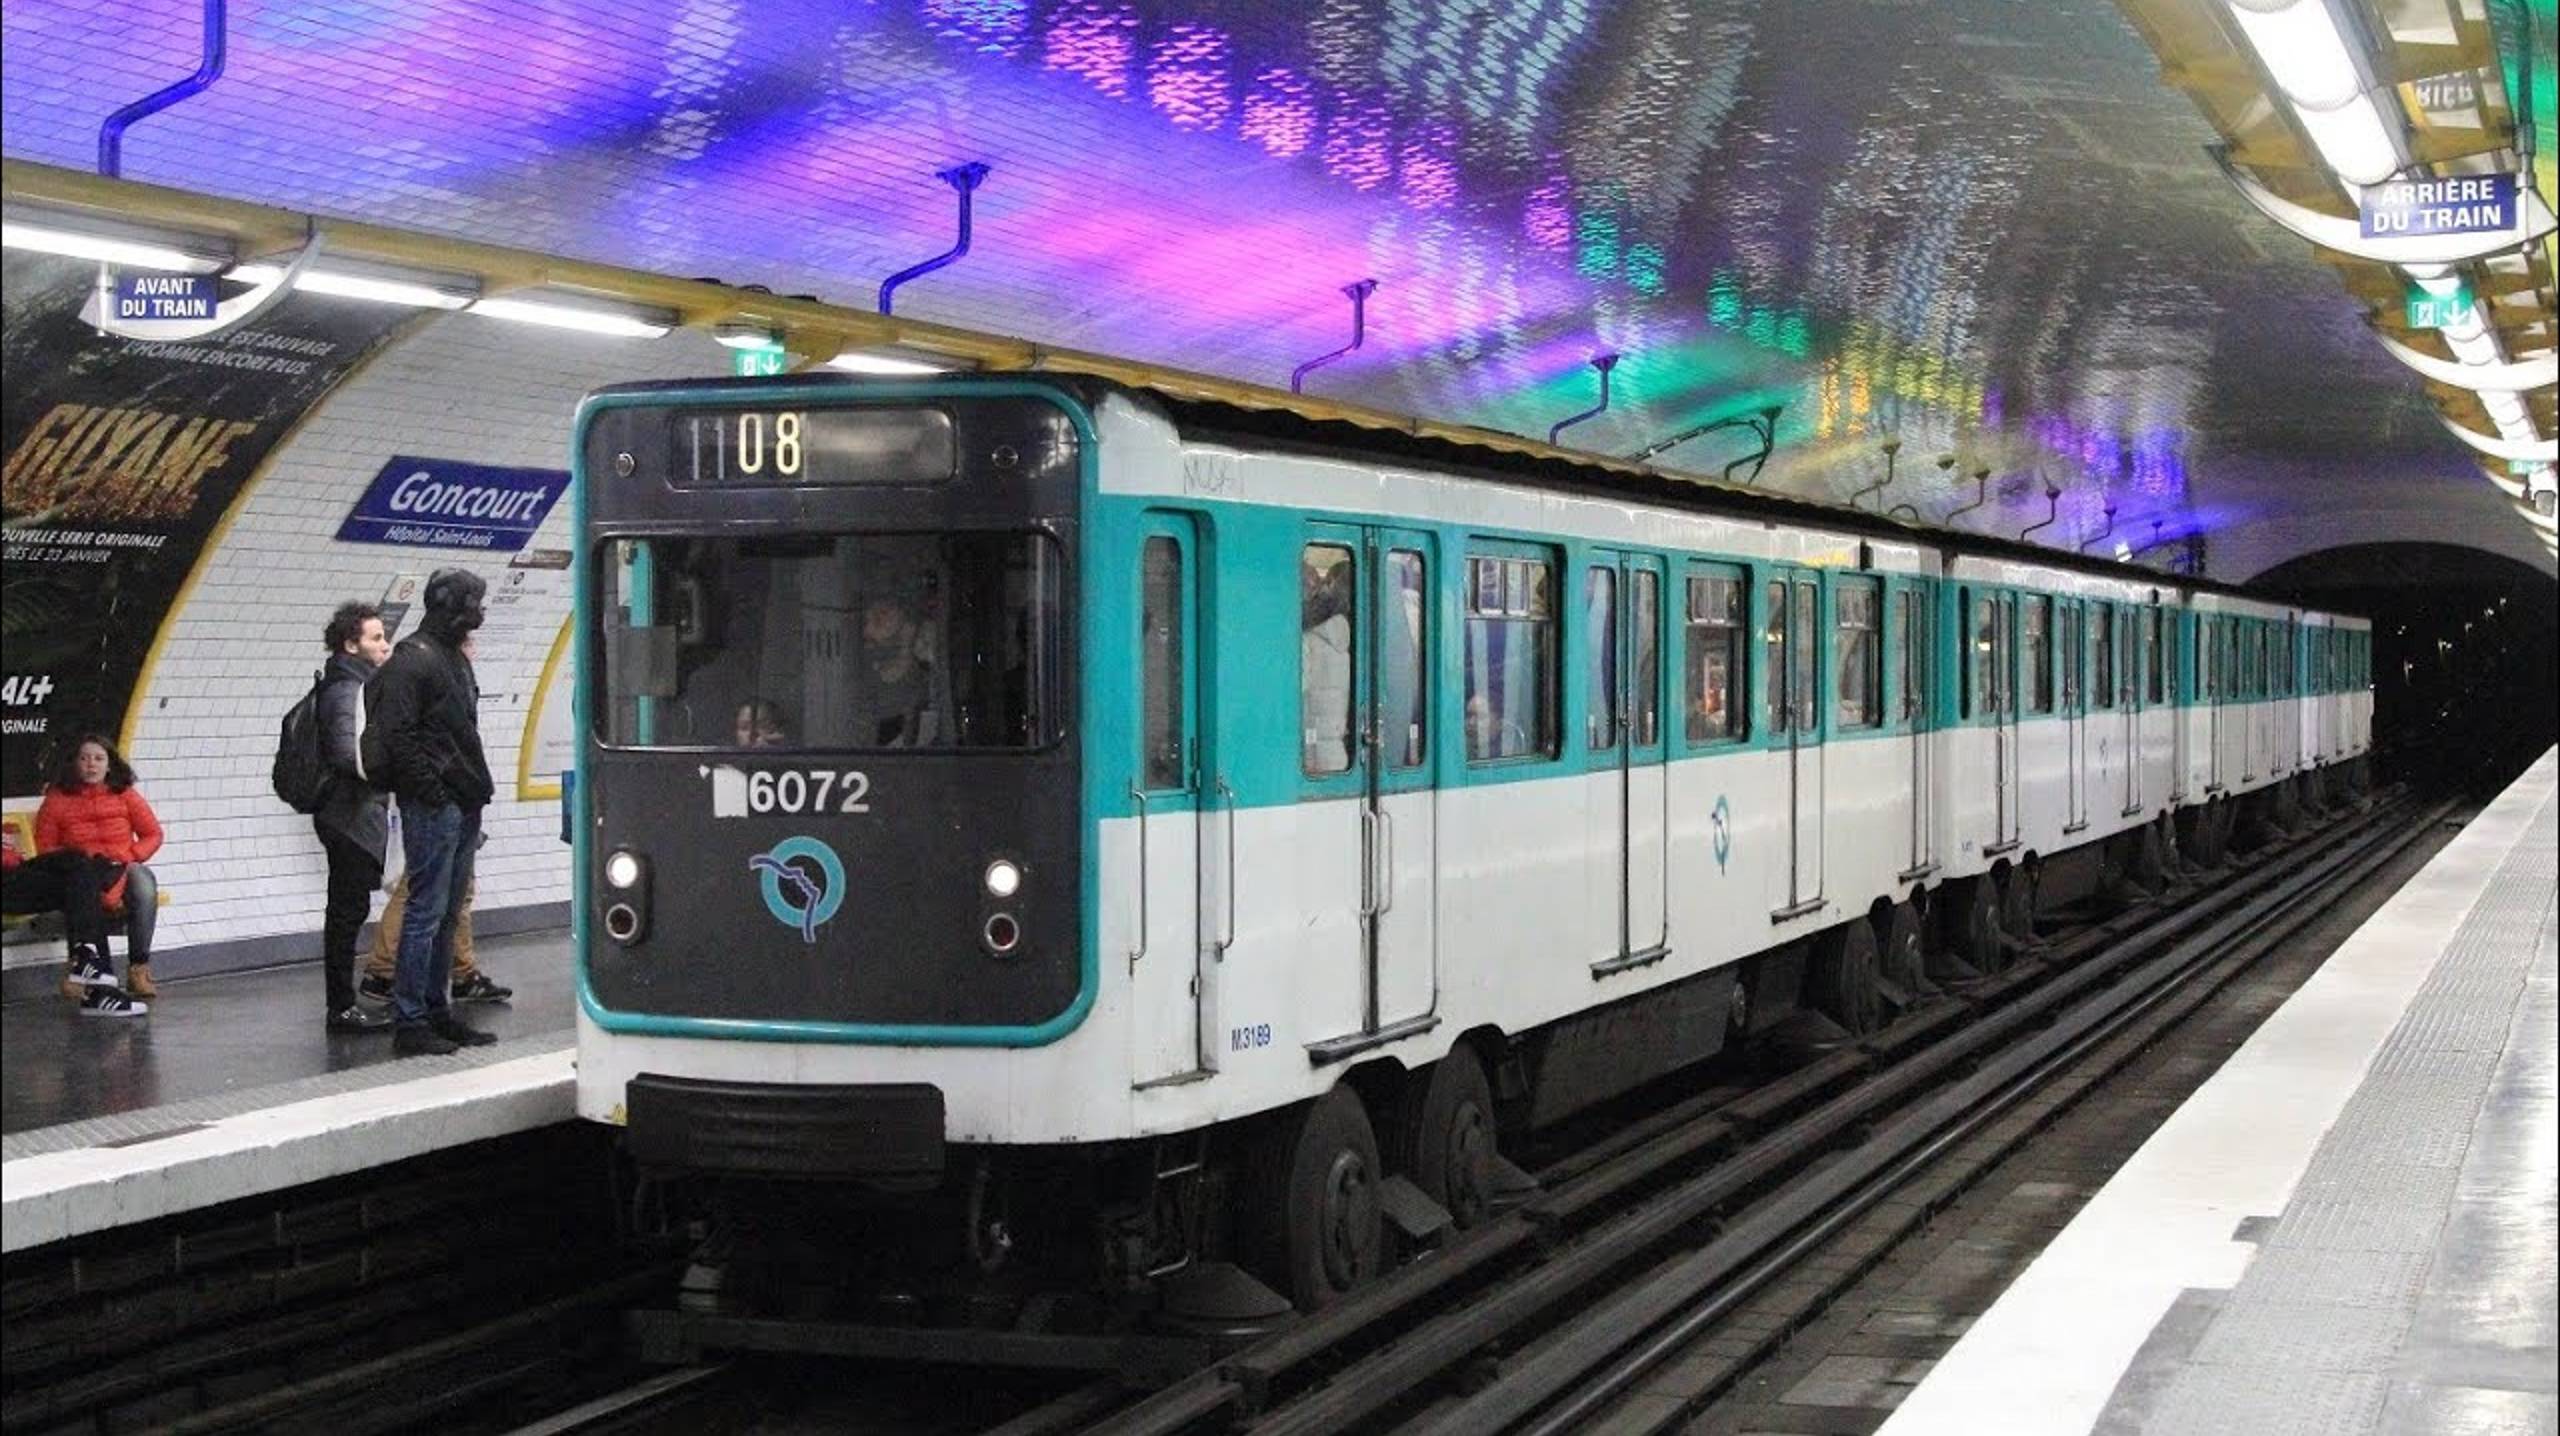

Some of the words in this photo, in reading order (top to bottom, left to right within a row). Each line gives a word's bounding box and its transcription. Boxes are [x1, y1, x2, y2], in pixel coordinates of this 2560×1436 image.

[2381, 178, 2495, 206] ARRIÈRE
[2373, 210, 2409, 232] DU
[2420, 205, 2501, 229] TRAIN
[134, 278, 195, 295] AVANT
[122, 299, 146, 316] DU
[152, 299, 207, 317] TRAIN
[257, 333, 336, 356] SAUVAGE
[201, 349, 273, 370] ENCORE
[267, 357, 311, 375] PLUS
[739, 412, 800, 474] 08
[2, 403, 257, 518] GUYANE
[390, 472, 548, 520] Goncourt
[95, 533, 167, 547] ORIGINALE
[384, 526, 432, 543] Hôpital
[430, 528, 495, 547] Saint-Louis
[750, 770, 869, 812] 6072
